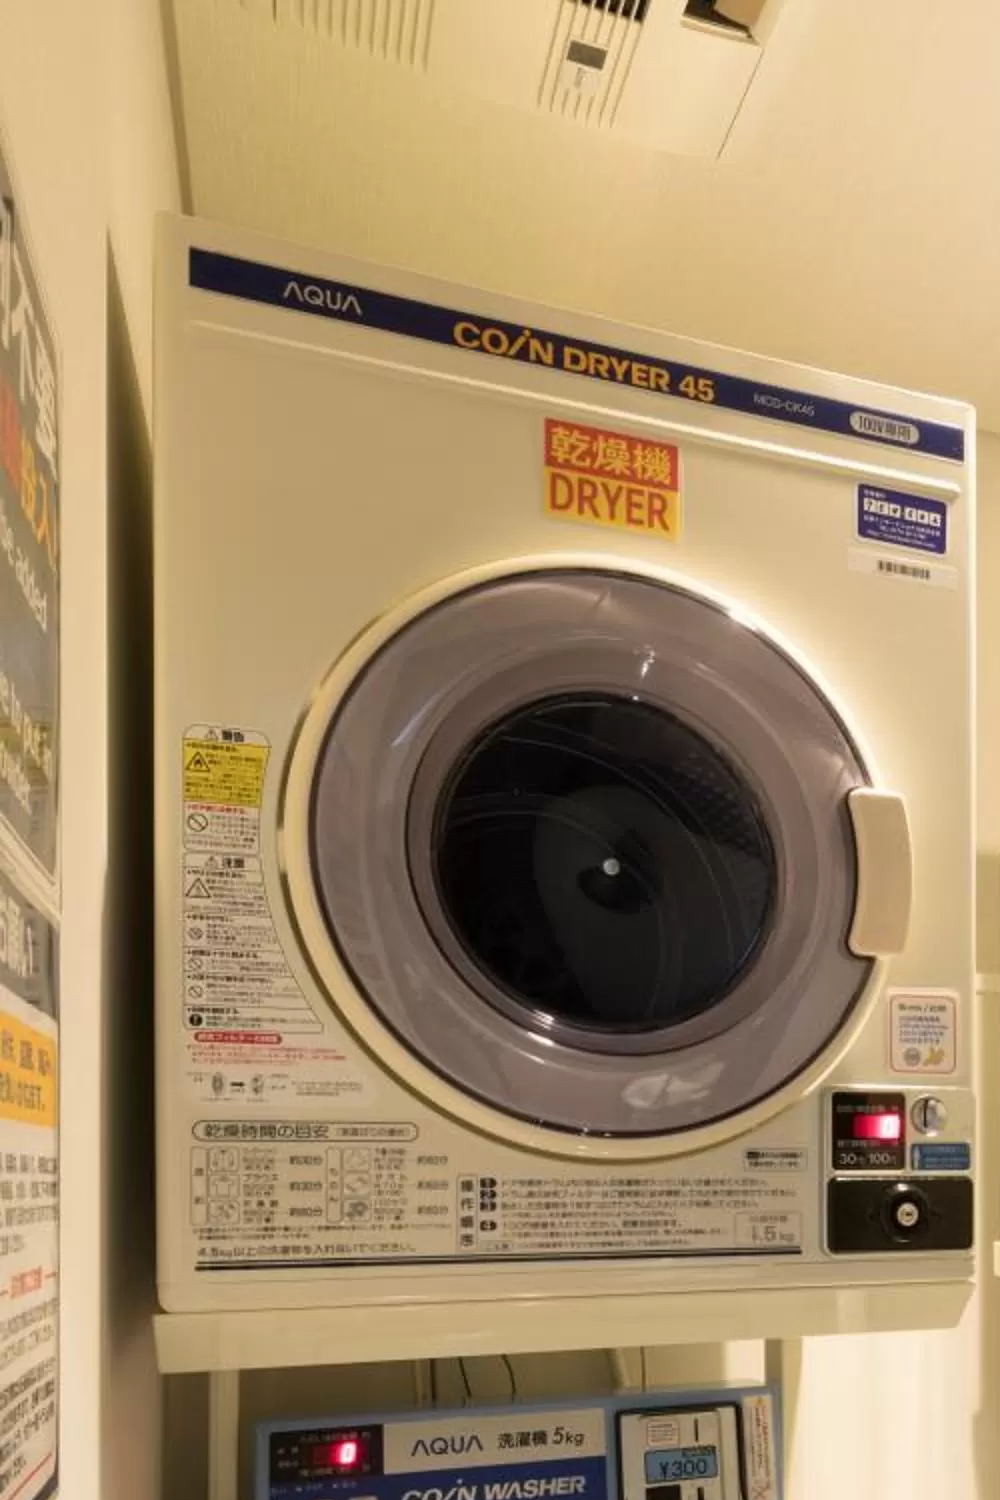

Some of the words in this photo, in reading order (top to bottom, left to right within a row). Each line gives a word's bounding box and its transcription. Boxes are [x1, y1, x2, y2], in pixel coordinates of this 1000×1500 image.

[283, 280, 364, 317] AQUA
[562, 345, 670, 393] DRYER
[678, 374, 717, 403] 45
[549, 425, 672, 487] 乾燥機
[548, 470, 670, 534] DRYER
[410, 1434, 485, 1458] AQUA
[497, 1430, 549, 1450] 洗濯機
[551, 1425, 586, 1448] 5kg
